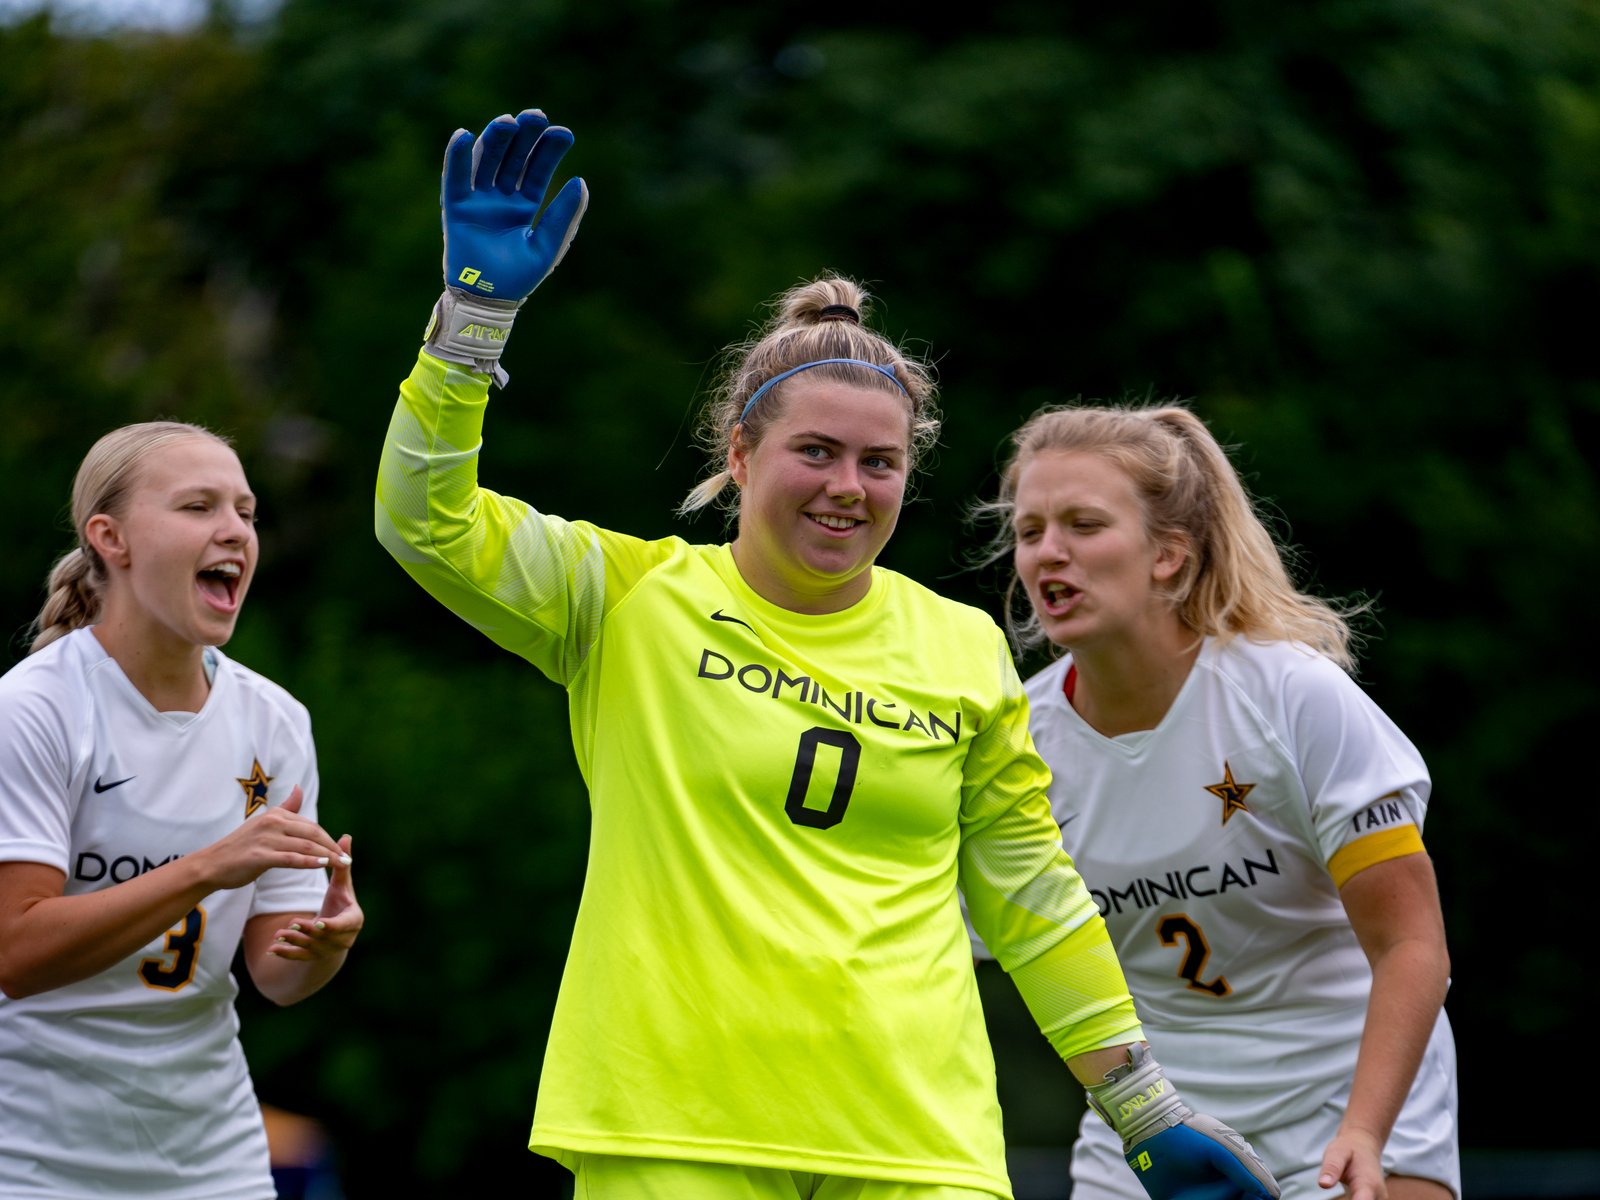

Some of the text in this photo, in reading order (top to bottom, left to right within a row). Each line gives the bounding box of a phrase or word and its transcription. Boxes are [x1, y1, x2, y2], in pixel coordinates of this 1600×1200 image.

[697, 648, 961, 744] DOMINICAN
[784, 726, 862, 830] 0
[1090, 849, 1280, 917] OMINICAN
[137, 903, 207, 992] 3
[1155, 912, 1233, 997] 2
